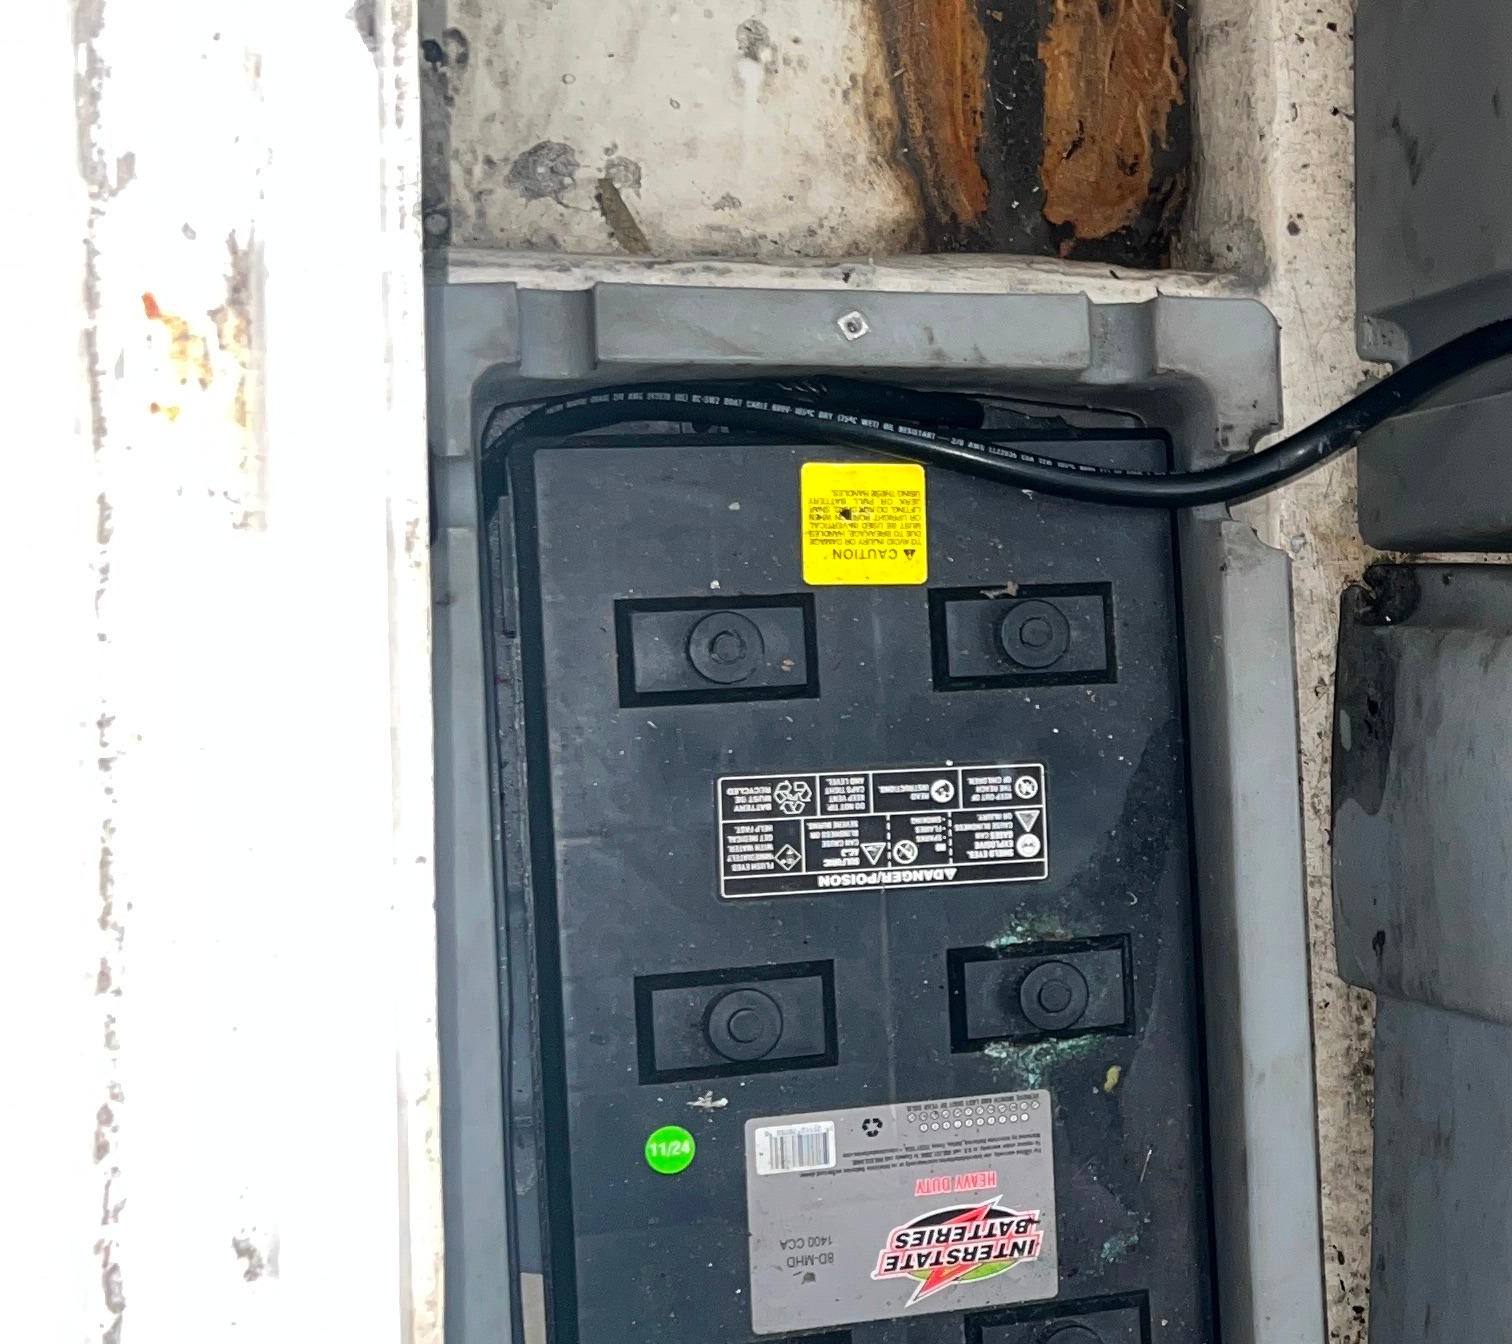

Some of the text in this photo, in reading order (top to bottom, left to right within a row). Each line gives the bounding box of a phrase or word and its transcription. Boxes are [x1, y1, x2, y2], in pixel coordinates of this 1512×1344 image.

[833, 549, 898, 559] CAUTION
[818, 868, 944, 887] DANGER/POISON
[650, 1140, 690, 1157] 11/24
[914, 1171, 996, 1196] HEAVY DUTY
[779, 1234, 832, 1251] 1400 CCA
[894, 1218, 1030, 1249] BATTERIES
[786, 1251, 834, 1268] 8D-MHD
[883, 1238, 1036, 1273] INTERSTATE
